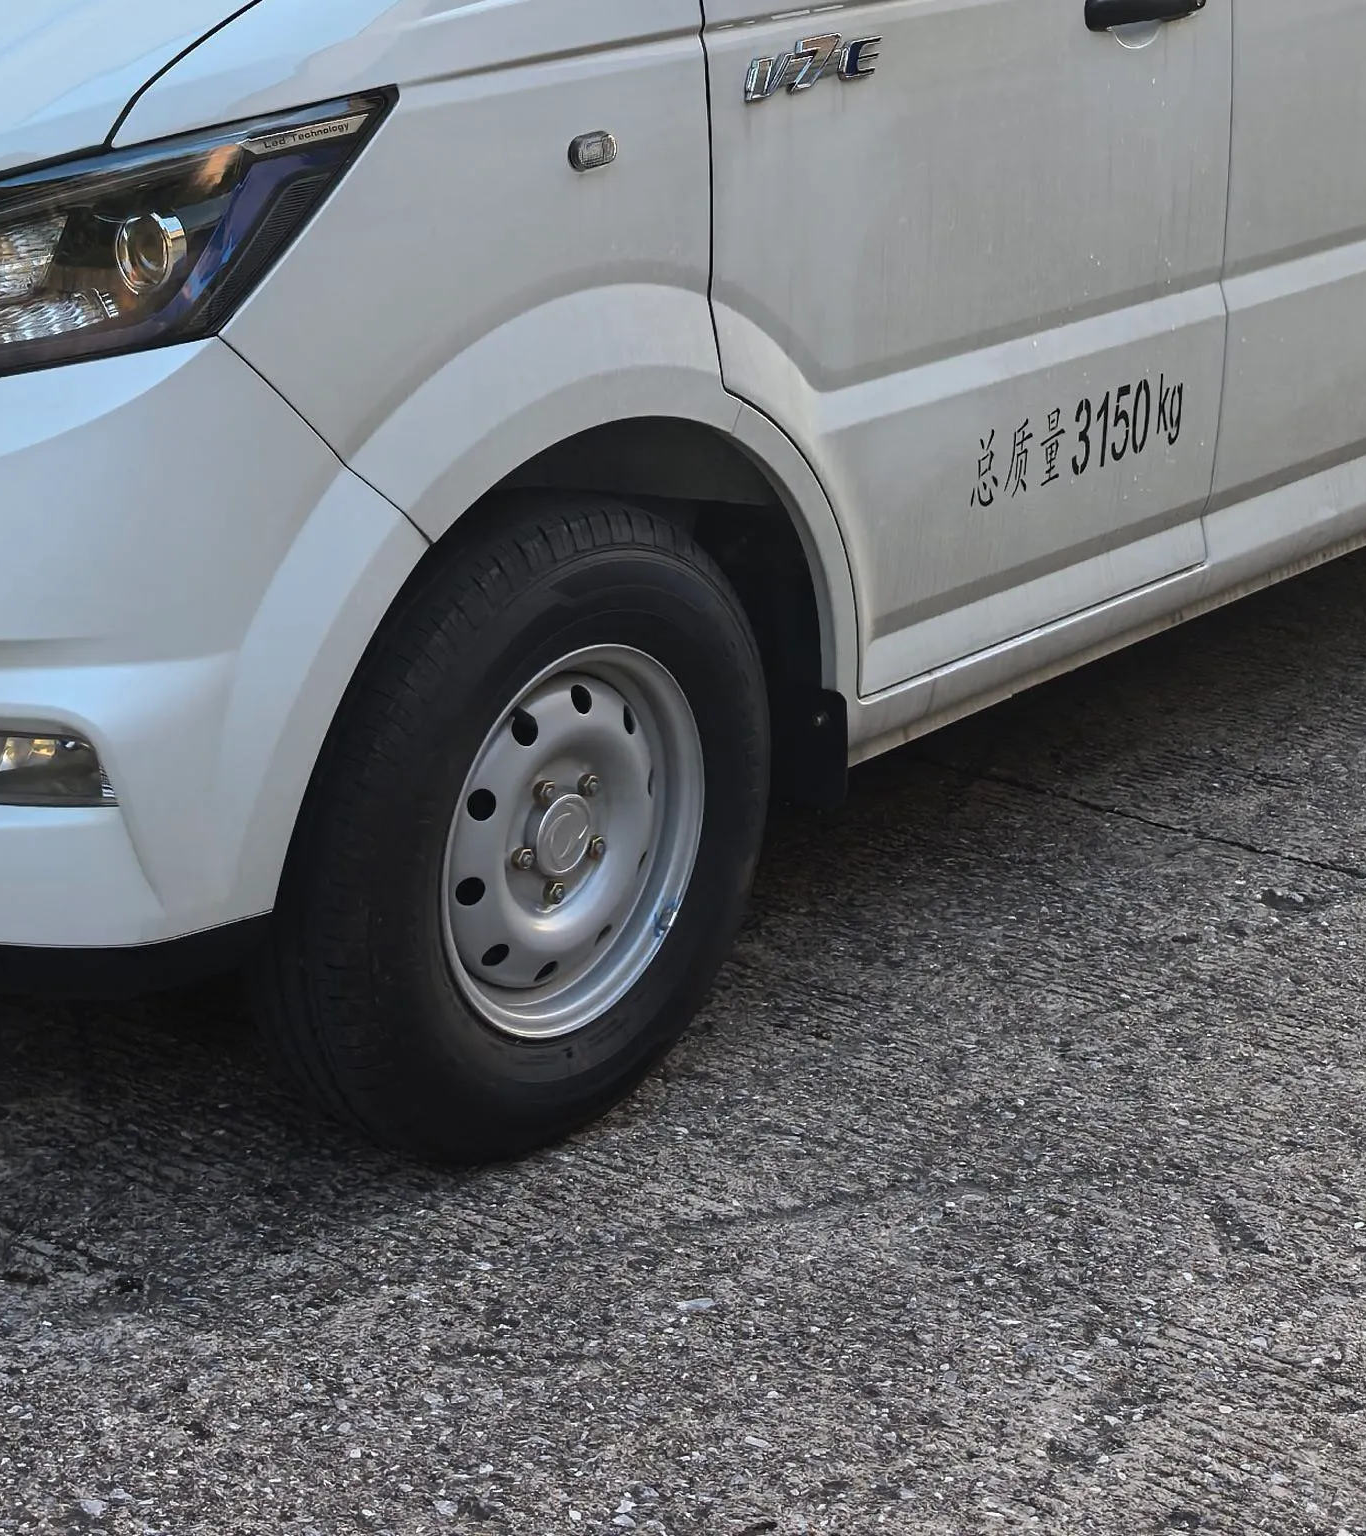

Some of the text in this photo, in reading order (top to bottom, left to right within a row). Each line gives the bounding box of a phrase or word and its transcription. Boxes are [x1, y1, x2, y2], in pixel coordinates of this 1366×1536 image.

[291, 123, 349, 142] Technology
[970, 373, 1184, 507] 总质量 3150 kg
